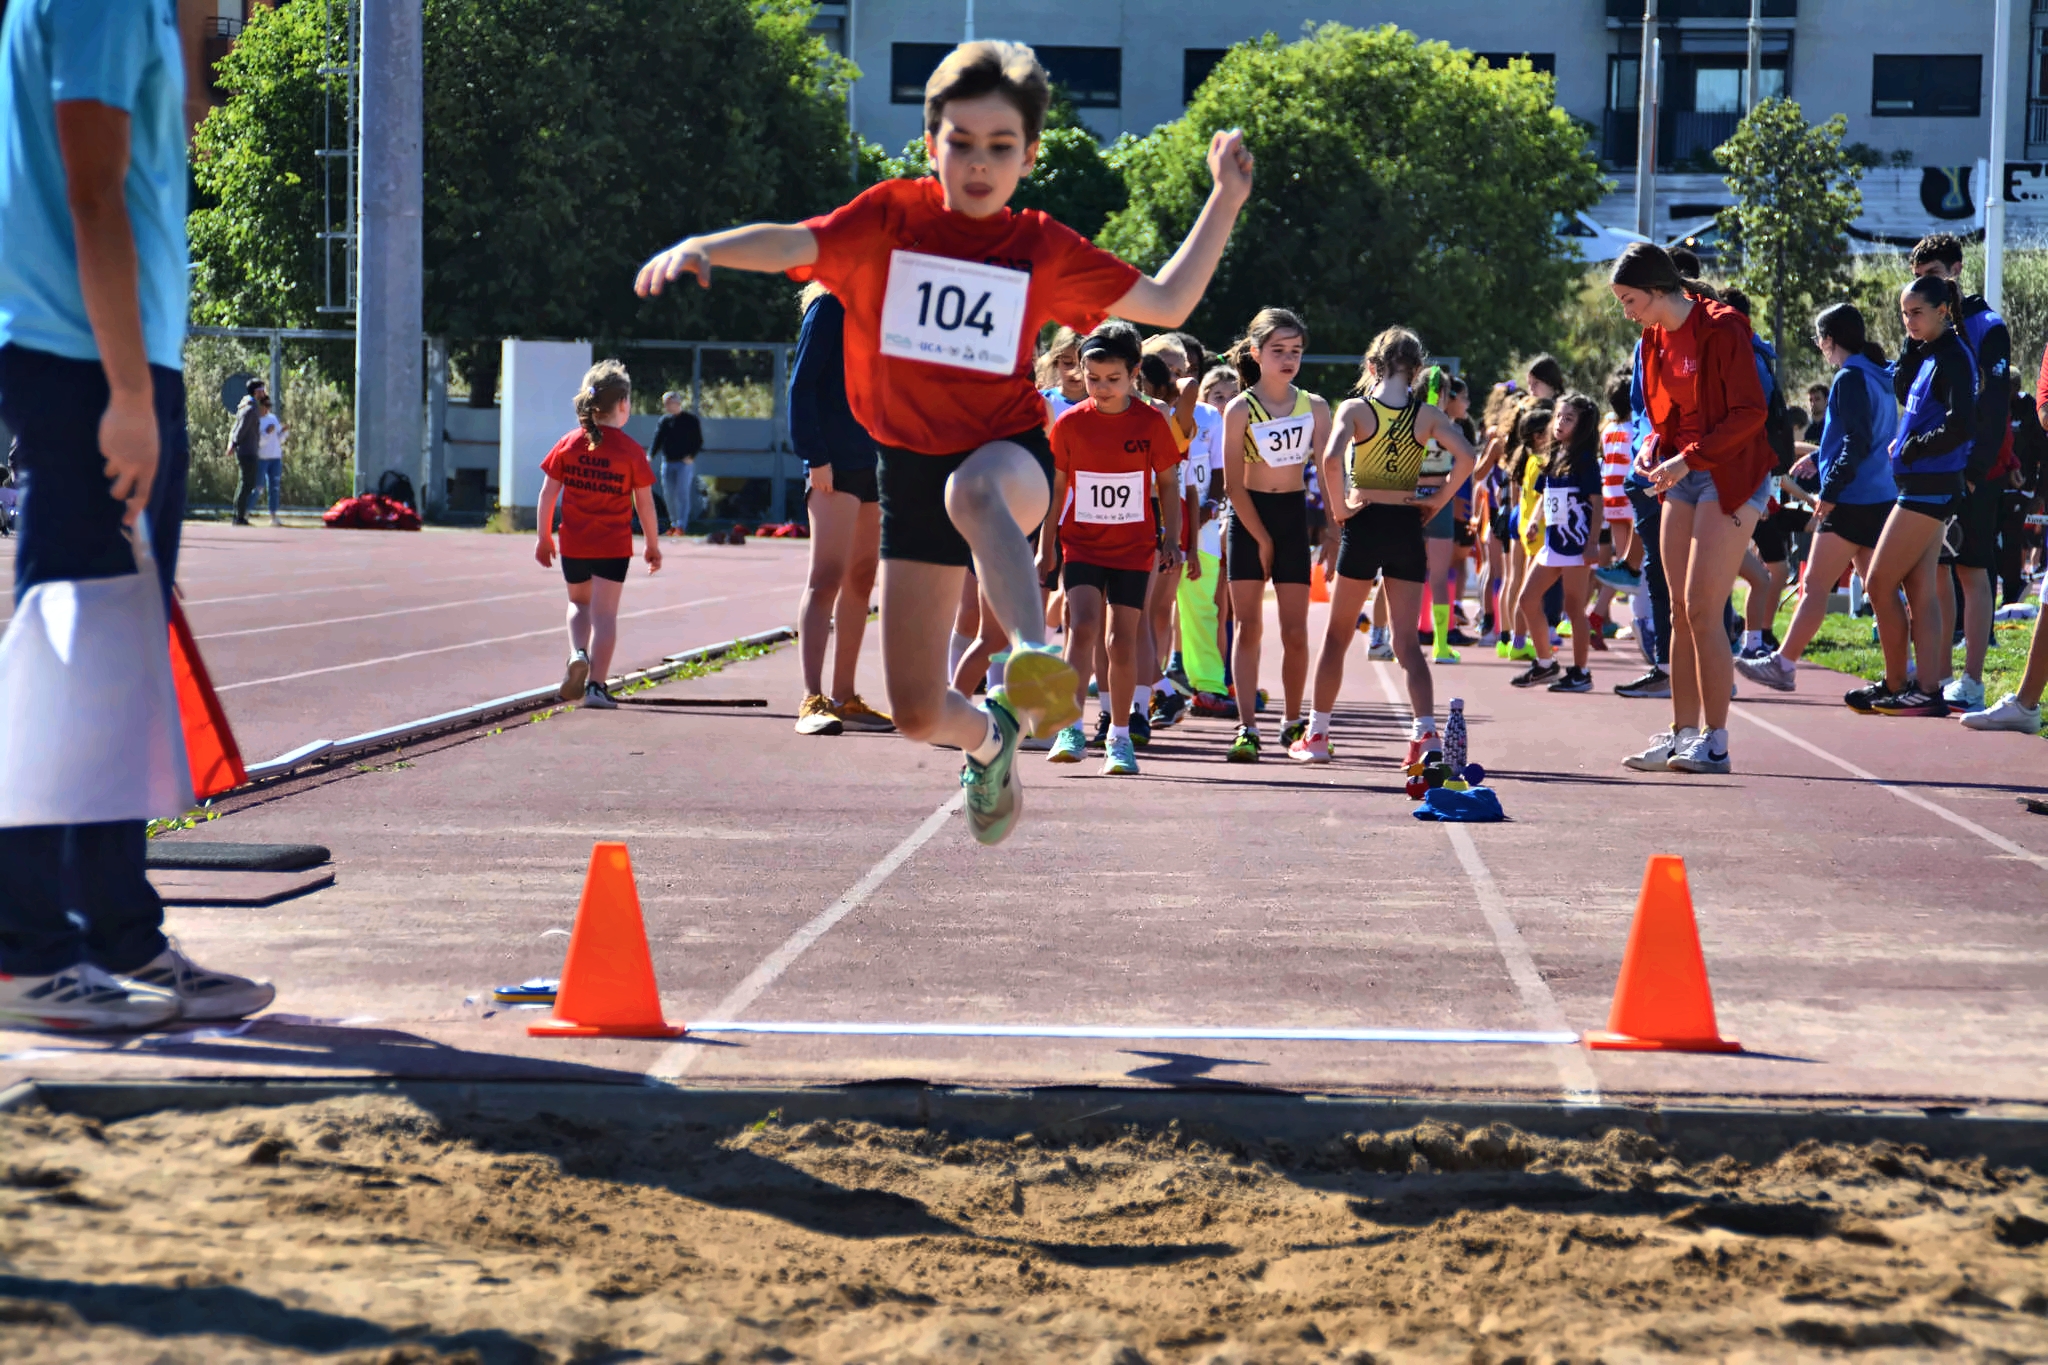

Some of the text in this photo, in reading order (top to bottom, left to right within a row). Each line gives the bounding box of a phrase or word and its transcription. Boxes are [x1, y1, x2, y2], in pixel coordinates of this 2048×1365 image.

[917, 281, 994, 337] 104
[1268, 426, 1303, 452] 317
[578, 455, 610, 468] CLUB
[1090, 485, 1131, 509] 109
